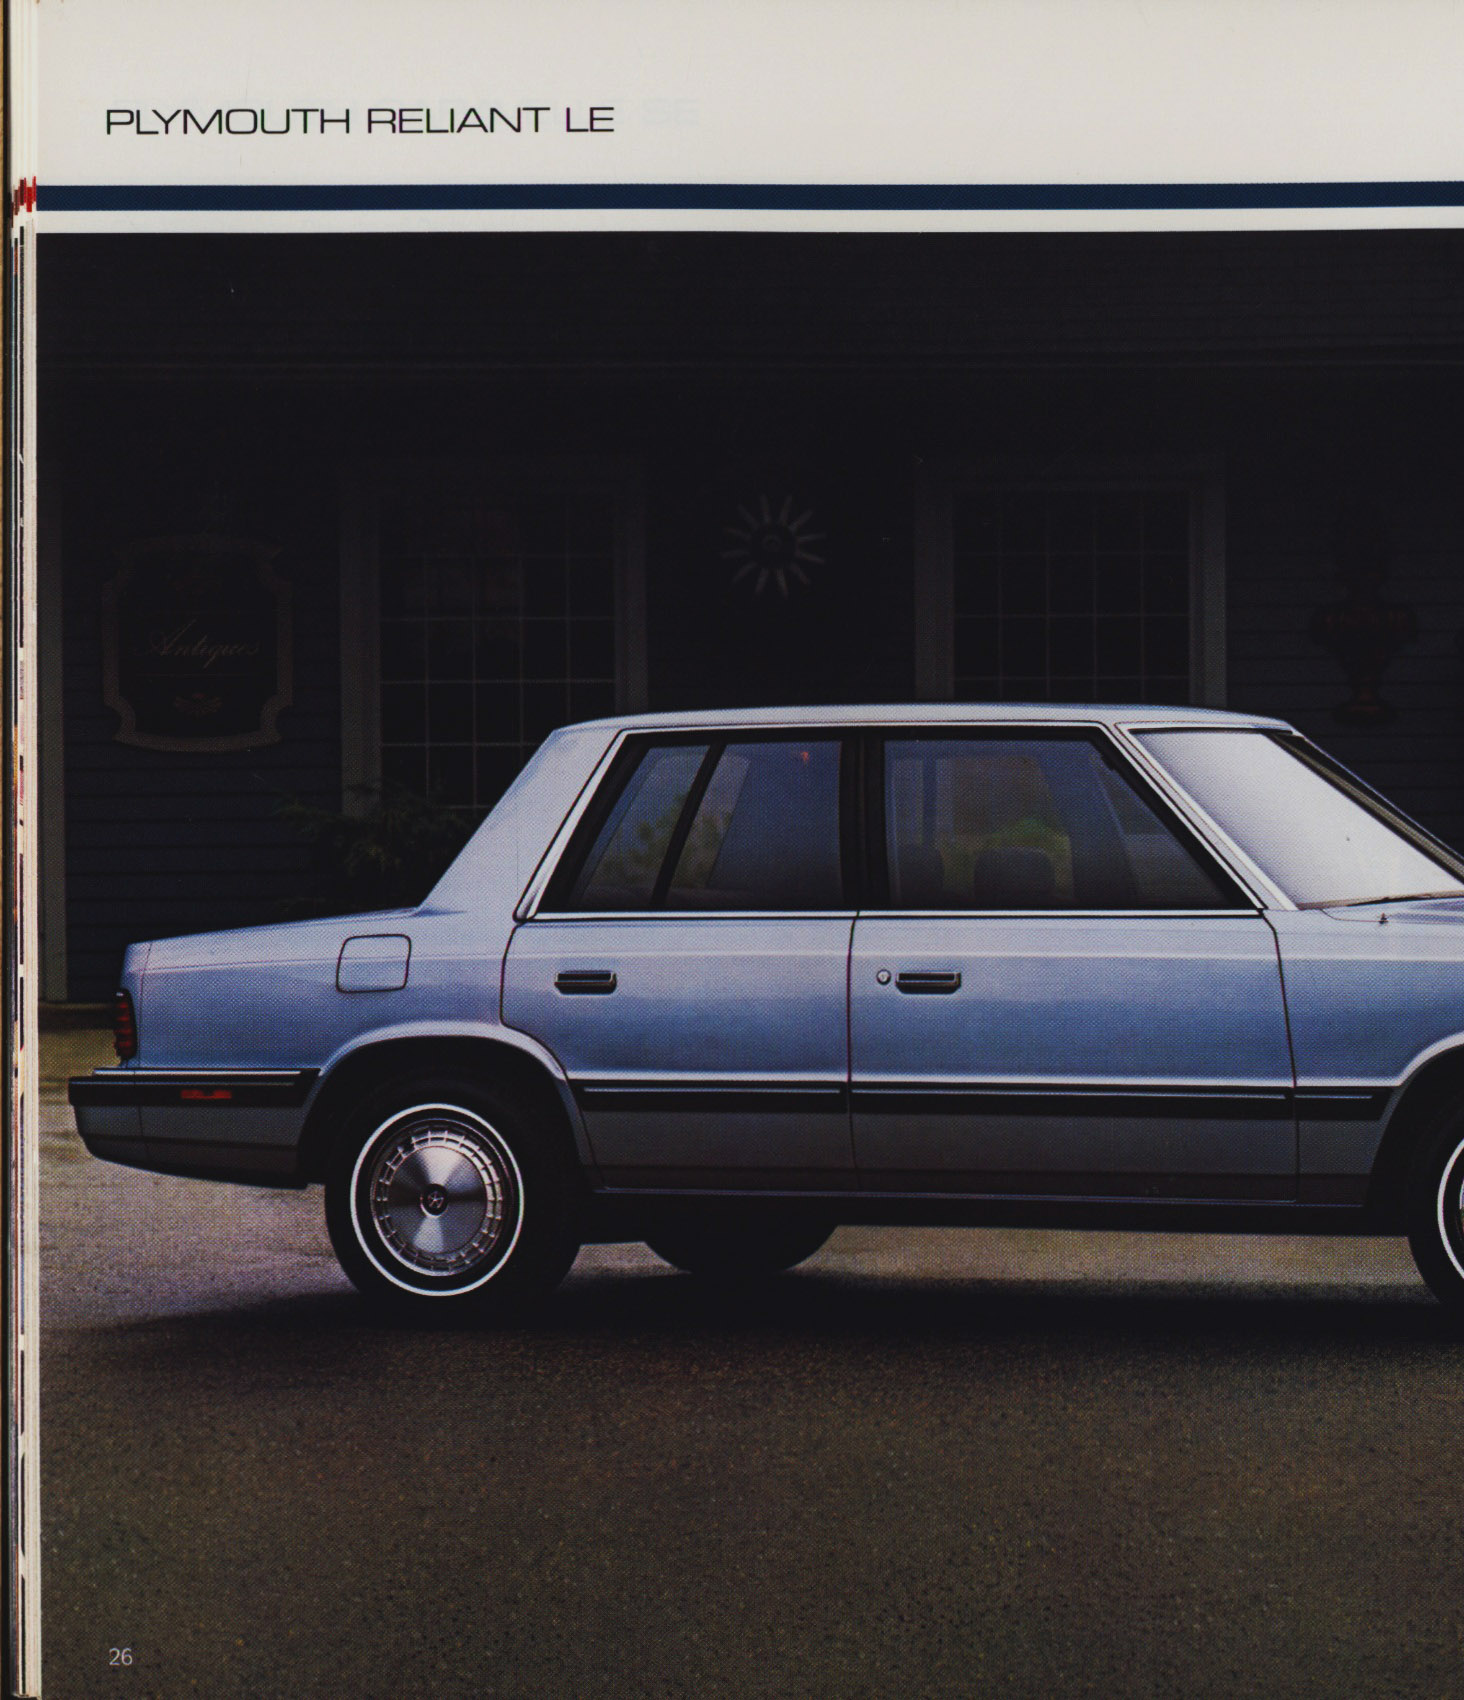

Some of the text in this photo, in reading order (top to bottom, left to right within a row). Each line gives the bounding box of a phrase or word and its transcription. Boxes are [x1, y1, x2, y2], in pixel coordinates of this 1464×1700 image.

[106, 108, 351, 136] PLYMOUTH
[367, 106, 551, 135] RELIANT
[565, 106, 615, 133] LE
[109, 1647, 133, 1666] 26
